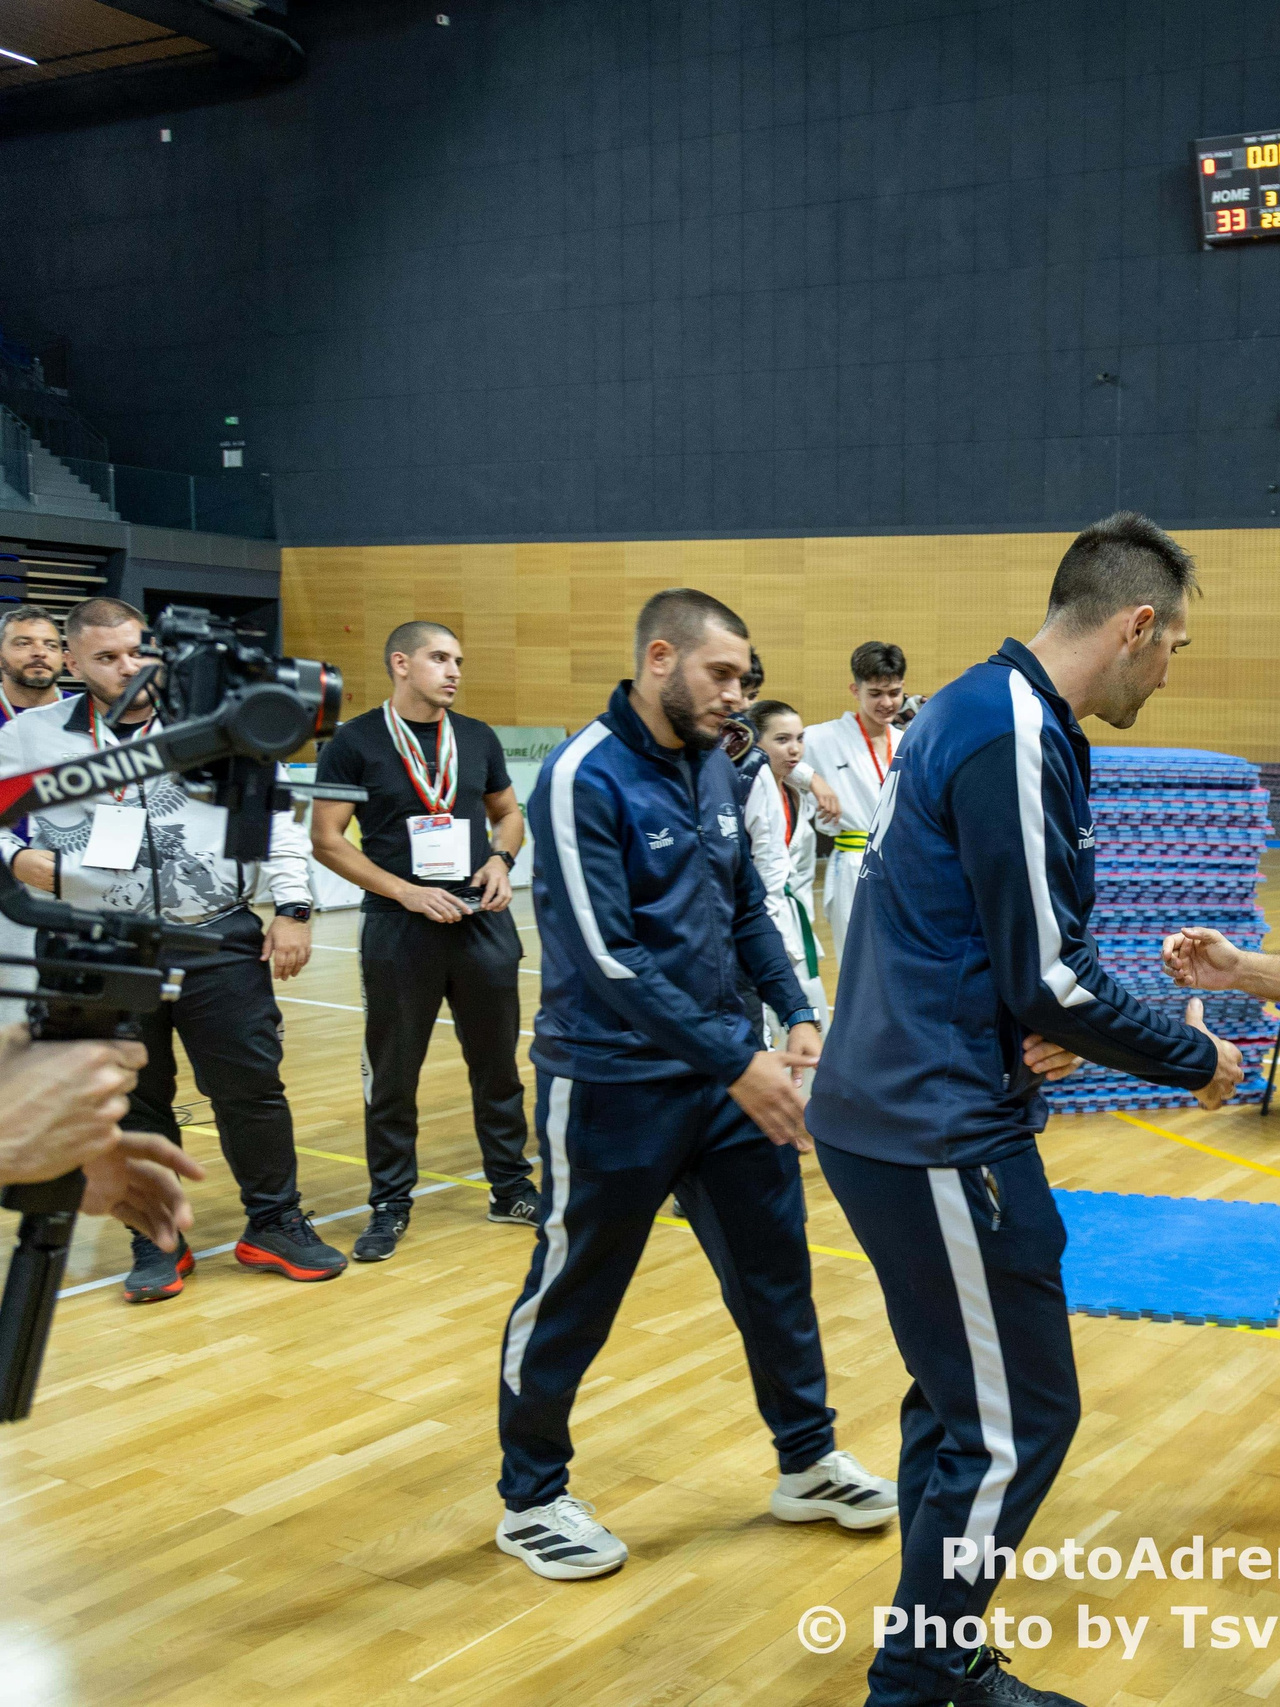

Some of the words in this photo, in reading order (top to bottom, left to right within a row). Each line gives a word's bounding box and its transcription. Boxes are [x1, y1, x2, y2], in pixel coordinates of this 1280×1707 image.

[1211, 188, 1251, 204] HOME
[1265, 190, 1278, 207] 3
[1216, 208, 1247, 232] 33
[33, 743, 165, 803] RONIN
